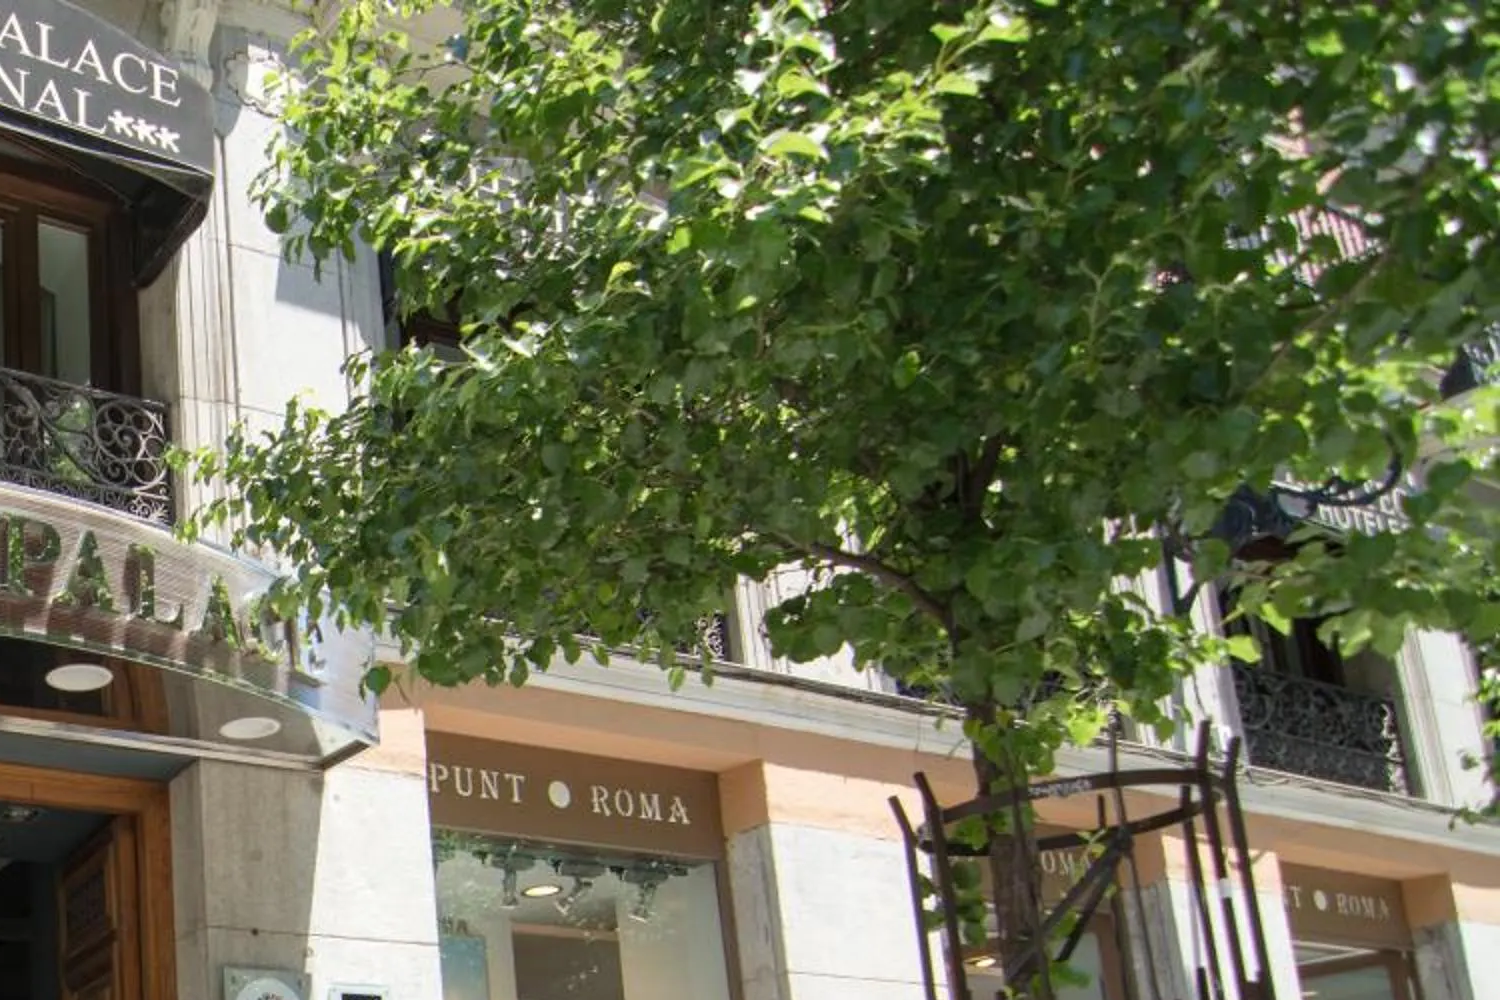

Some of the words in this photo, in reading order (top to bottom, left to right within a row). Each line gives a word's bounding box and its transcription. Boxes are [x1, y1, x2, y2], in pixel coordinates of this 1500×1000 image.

[429, 762, 525, 804] PUNT
[590, 785, 691, 825] ROMA
[1336, 893, 1390, 922] ROMA
